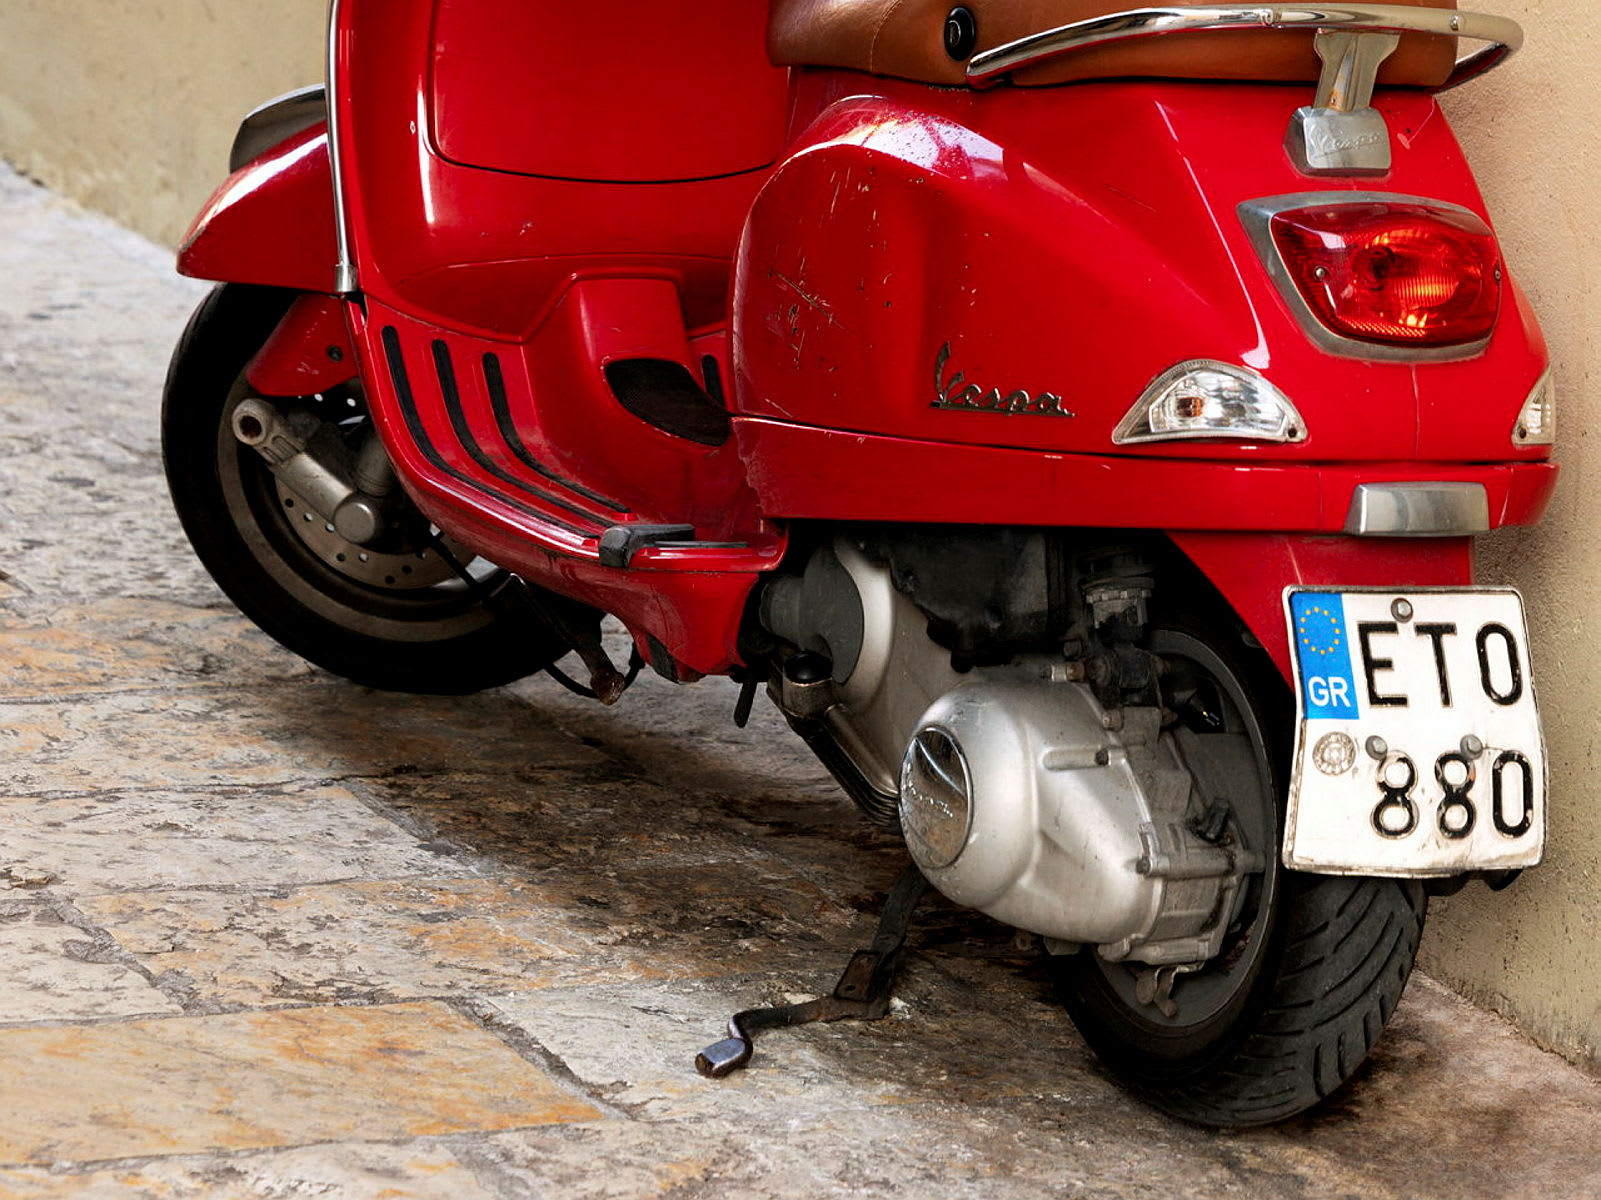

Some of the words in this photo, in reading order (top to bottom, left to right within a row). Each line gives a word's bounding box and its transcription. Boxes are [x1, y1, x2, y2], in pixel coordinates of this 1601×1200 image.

[930, 341, 1075, 416] Vespa
[1308, 676, 1351, 707] GR
[1358, 621, 1523, 706] ETO
[1370, 750, 1534, 840] 880
